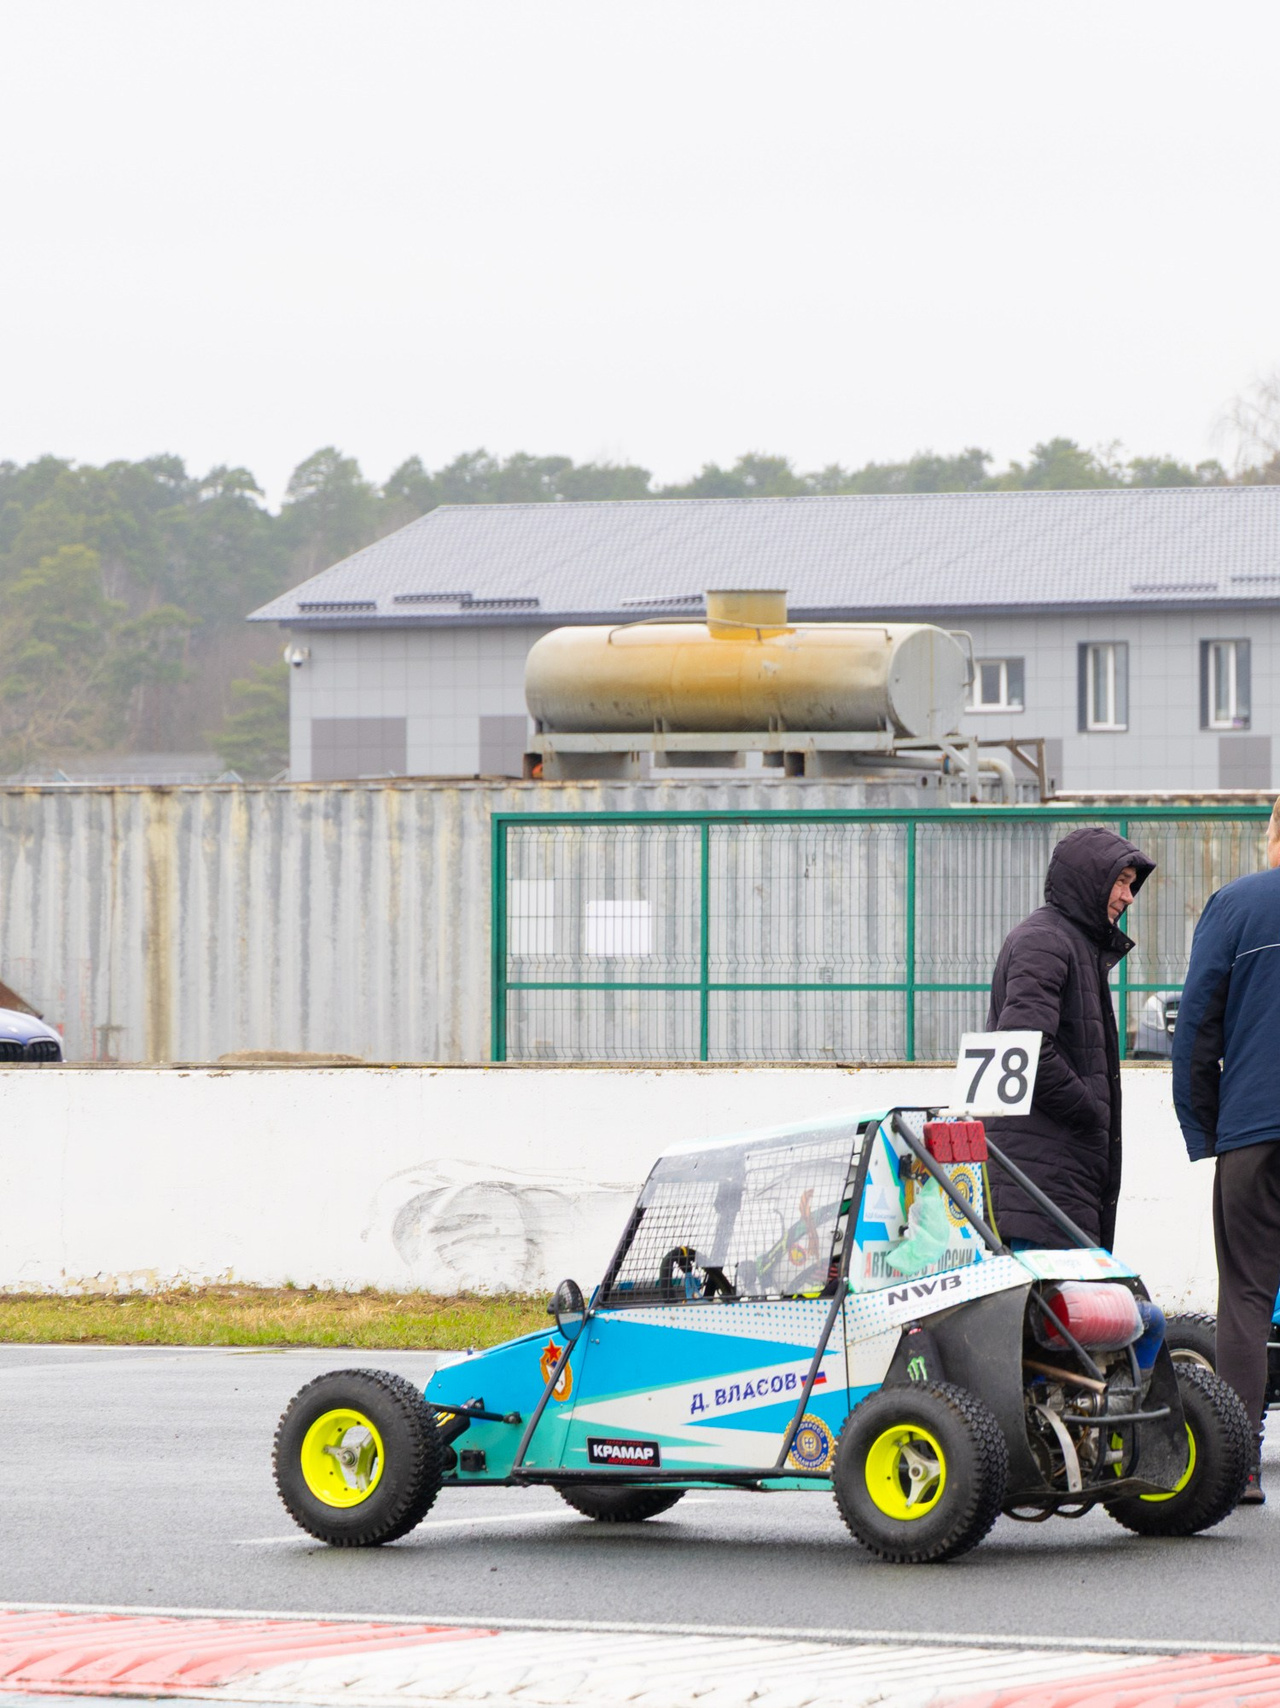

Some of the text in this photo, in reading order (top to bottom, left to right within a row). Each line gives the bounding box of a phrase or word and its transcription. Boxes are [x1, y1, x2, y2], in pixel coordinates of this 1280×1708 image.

[965, 1047, 1029, 1104] 78
[888, 1275, 962, 1306] NWB
[690, 1372, 797, 1415] Д. ВЛАСОВ
[593, 1445, 654, 1460] КРАМАР
